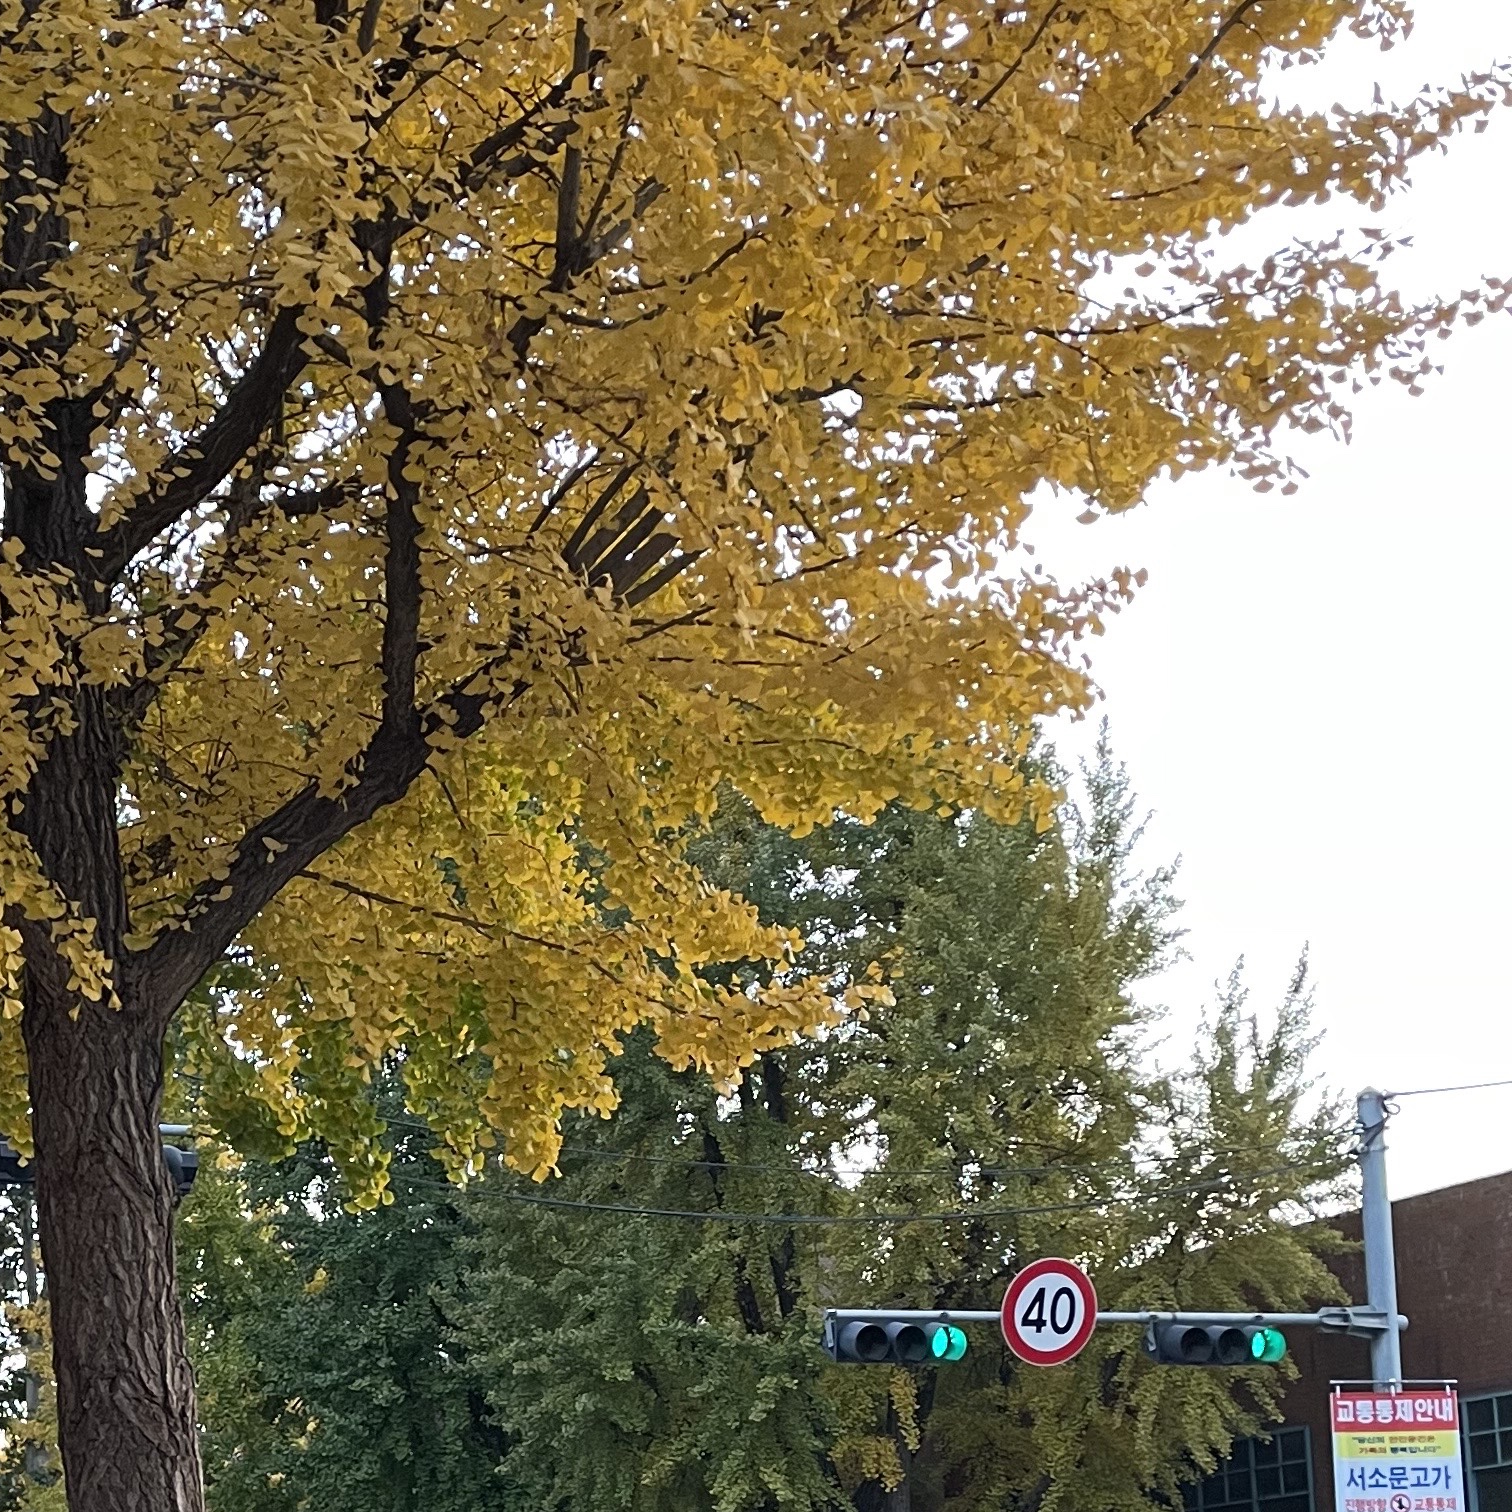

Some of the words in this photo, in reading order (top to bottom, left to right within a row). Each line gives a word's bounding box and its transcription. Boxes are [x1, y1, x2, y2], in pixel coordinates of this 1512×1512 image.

[1020, 1286, 1076, 1335] 40
[1336, 1398, 1454, 1424] 교통통제안내
[1347, 1465, 1452, 1491] 서소문고가
[1414, 1497, 1457, 1511] 교통통제
